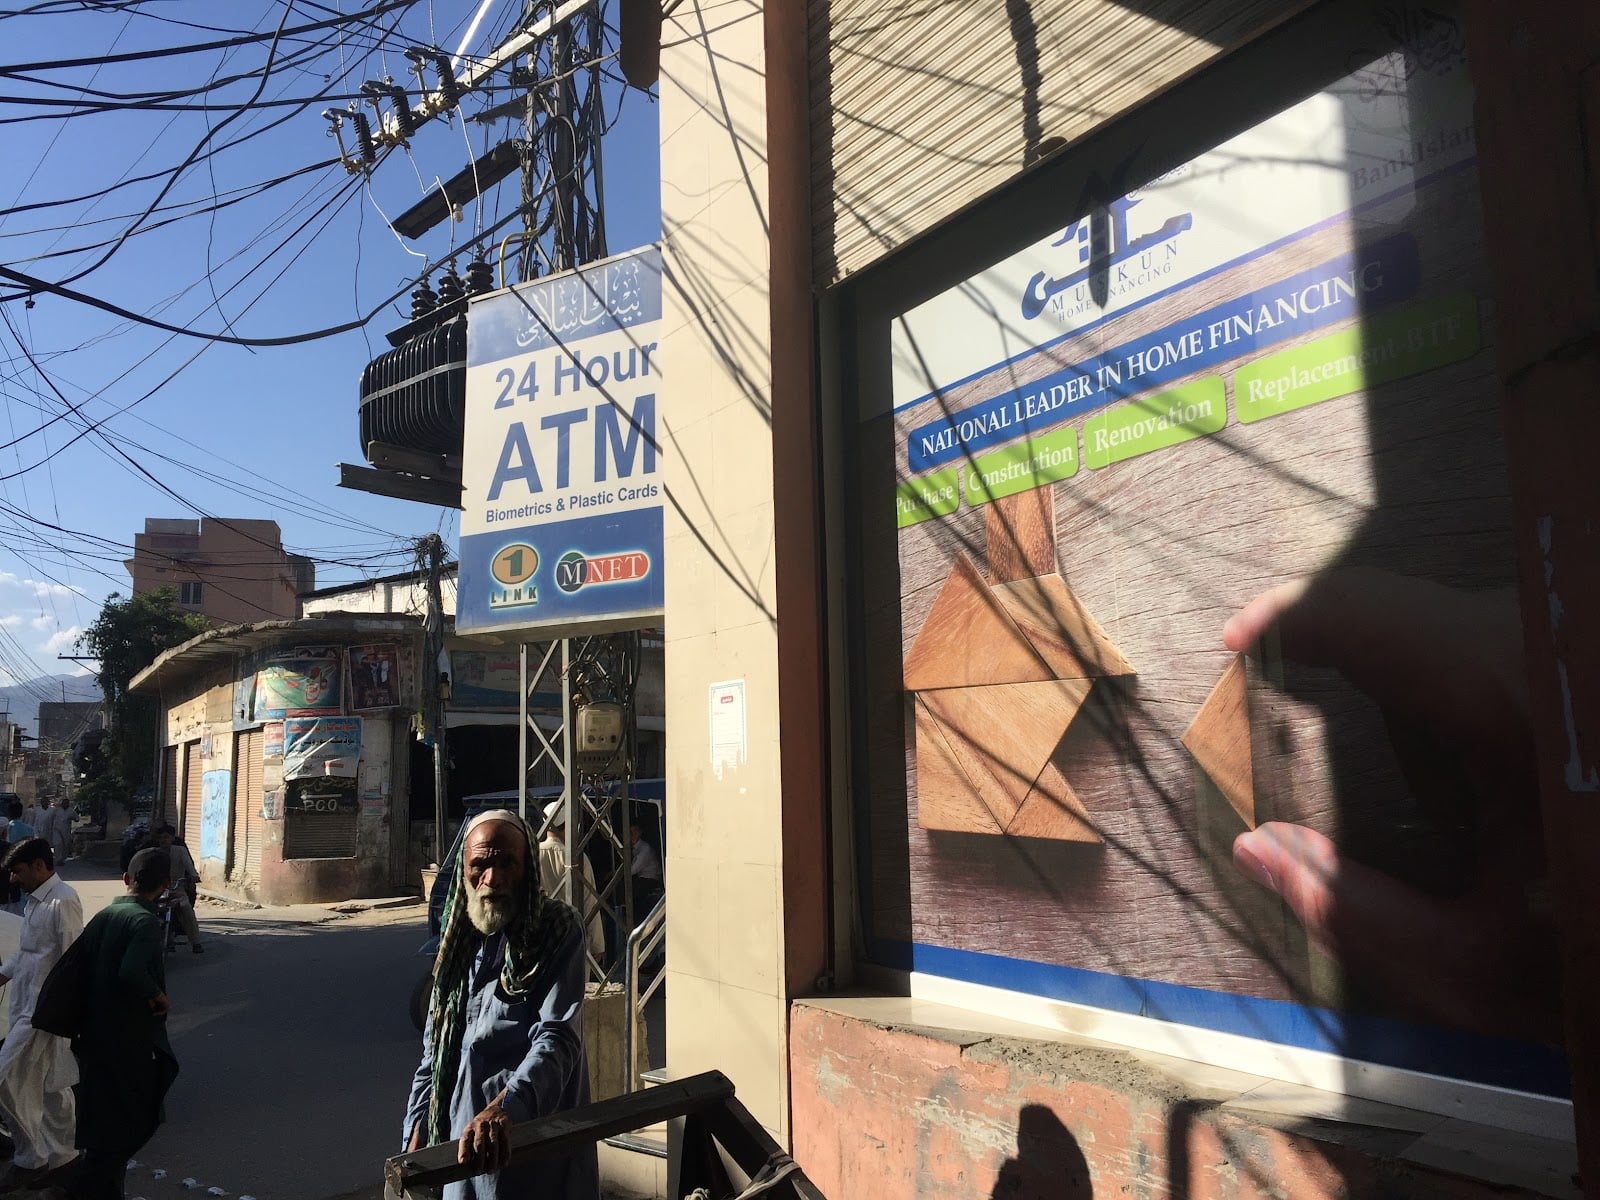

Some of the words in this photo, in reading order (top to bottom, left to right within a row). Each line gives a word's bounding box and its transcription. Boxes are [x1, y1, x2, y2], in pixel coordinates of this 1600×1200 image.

[1097, 262, 1171, 304] NANCING
[493, 360, 539, 410] 24
[553, 341, 658, 397] Hour
[921, 406, 1012, 458] NATIONAL
[1014, 369, 1093, 423] LEADER
[1097, 361, 1122, 391] IN
[1126, 329, 1204, 380] HOME
[1208, 261, 1384, 350] FINANCING
[1094, 398, 1213, 452] Renovation
[486, 393, 656, 501] ATM
[969, 446, 1073, 491] Construction
[486, 502, 552, 523] Biometrics
[556, 498, 566, 512] &
[569, 491, 613, 509] Plastic
[617, 483, 658, 501] Cards
[896, 485, 954, 515] Purchase
[502, 549, 523, 577] 1
[561, 554, 643, 586] MNET
[491, 587, 537, 604] LINK
[303, 799, 337, 812] PCO
